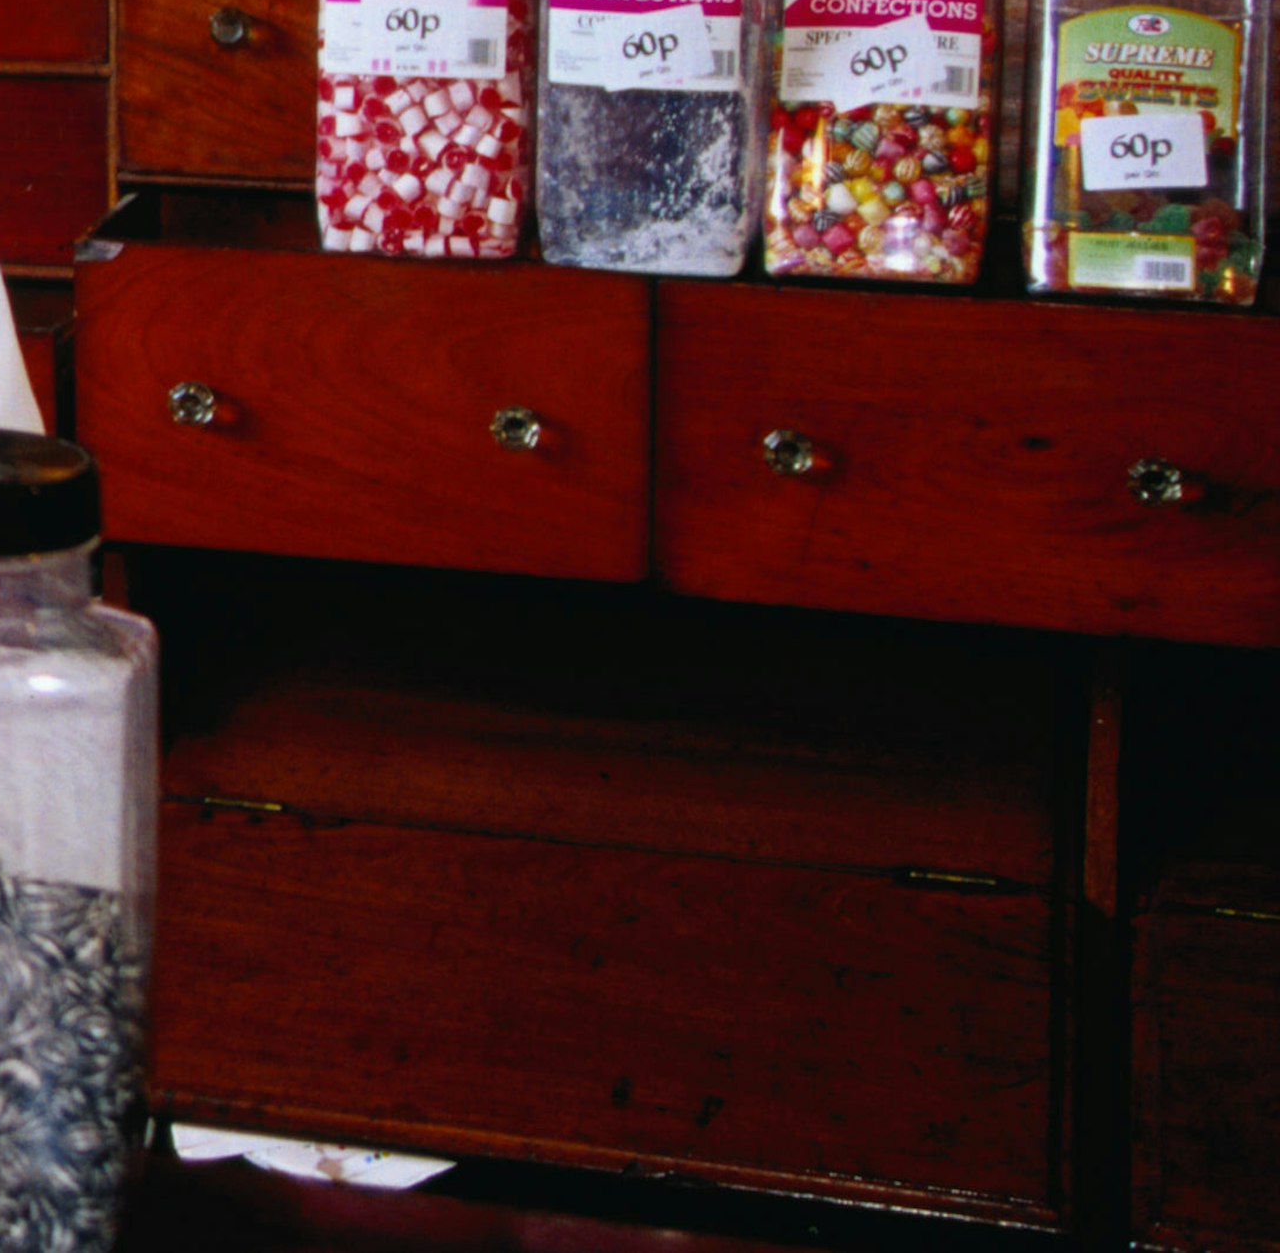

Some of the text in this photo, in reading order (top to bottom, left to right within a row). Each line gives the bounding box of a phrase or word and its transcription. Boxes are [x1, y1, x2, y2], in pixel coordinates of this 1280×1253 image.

[385, 8, 441, 40] 60p
[622, 31, 679, 62] 60p
[850, 44, 908, 77] 60p
[1084, 42, 1216, 70] SUPREME
[1107, 67, 1185, 83] QUALITY
[1078, 79, 1220, 108] SWEETS
[1110, 133, 1173, 167] 60p
